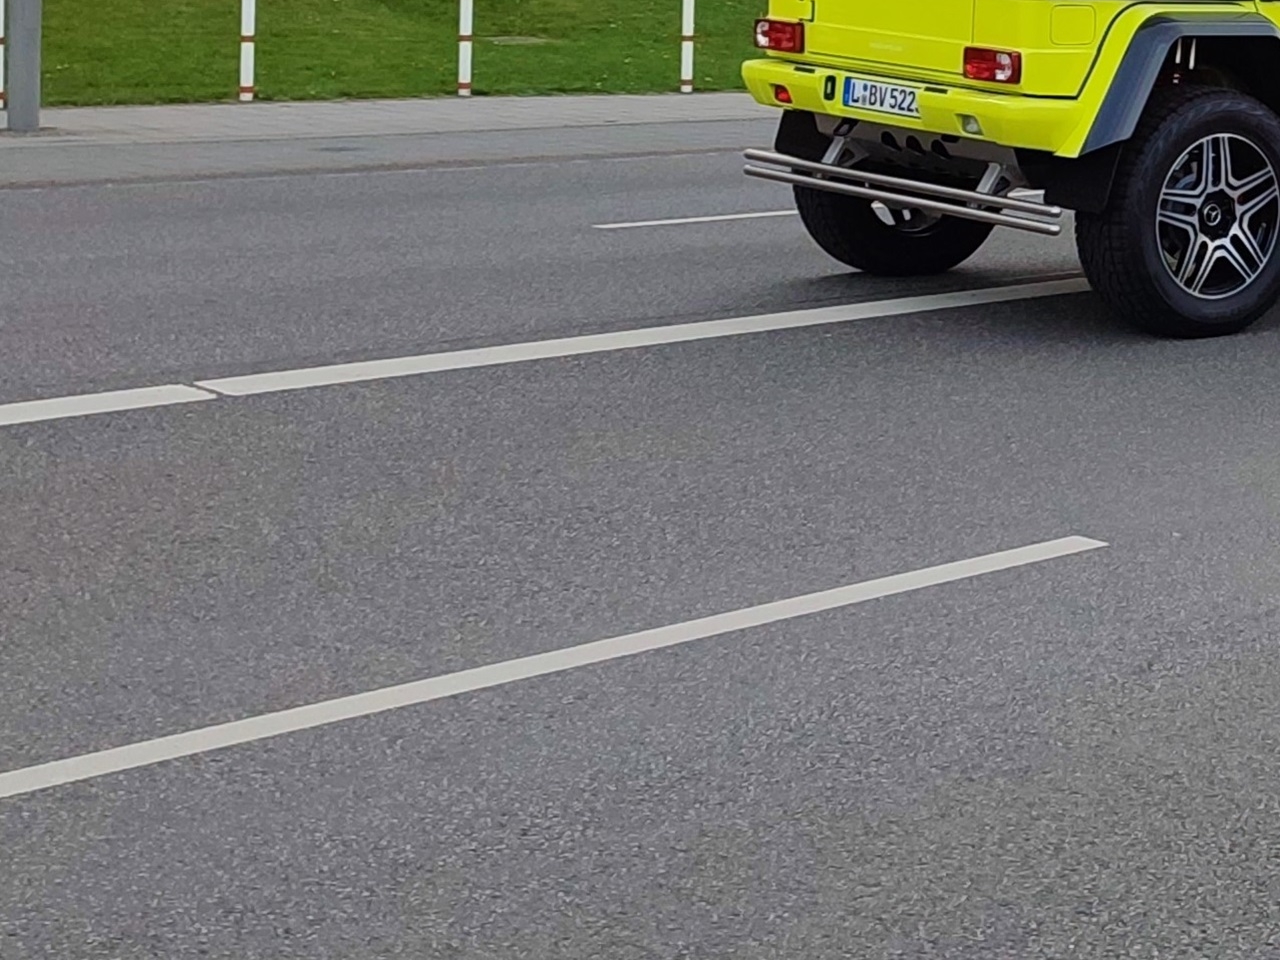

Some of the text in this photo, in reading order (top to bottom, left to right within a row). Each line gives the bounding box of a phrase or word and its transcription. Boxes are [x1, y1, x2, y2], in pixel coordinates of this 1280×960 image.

[851, 82, 920, 113] L BV 522
